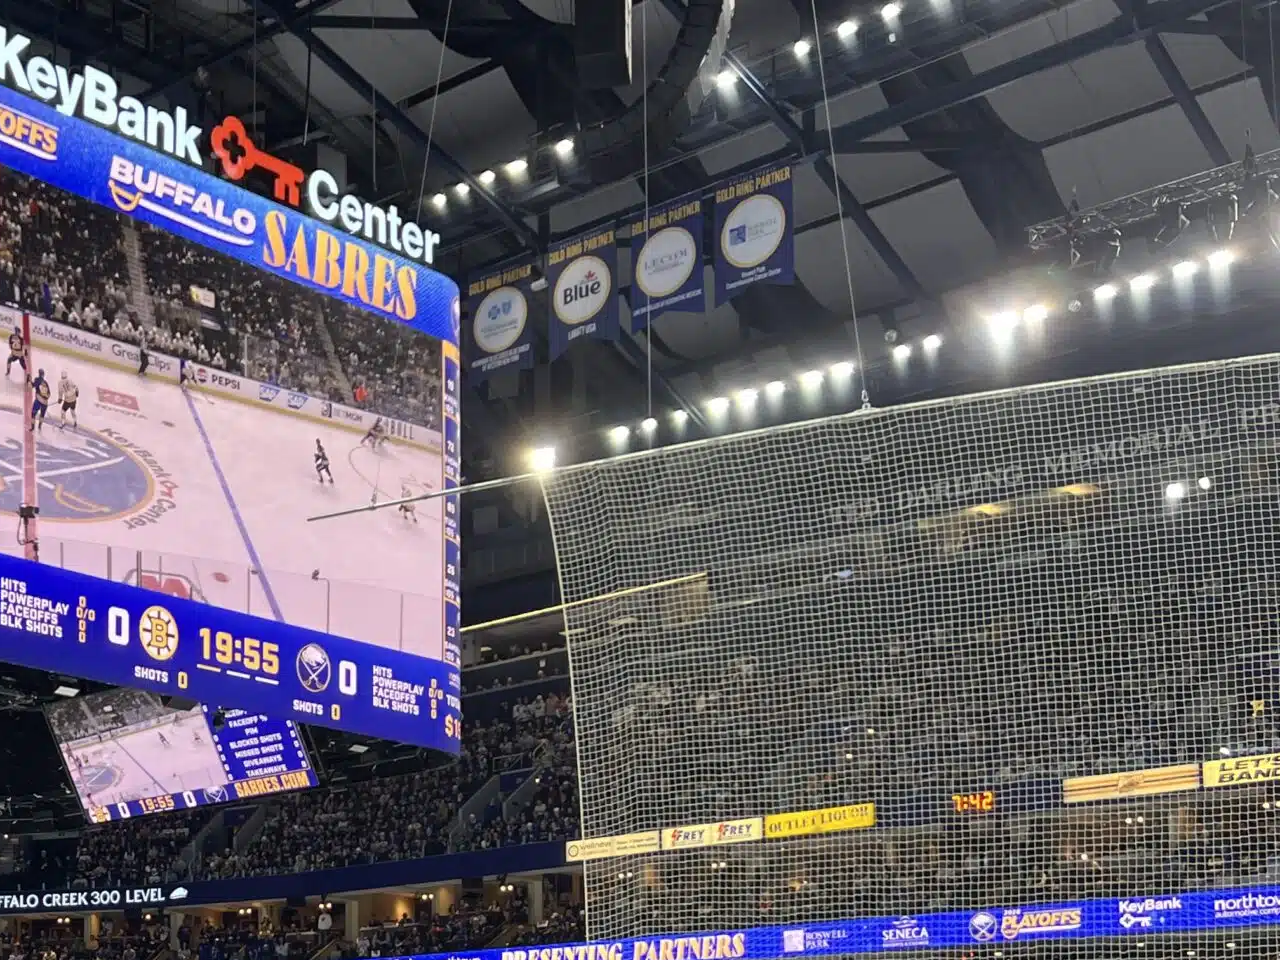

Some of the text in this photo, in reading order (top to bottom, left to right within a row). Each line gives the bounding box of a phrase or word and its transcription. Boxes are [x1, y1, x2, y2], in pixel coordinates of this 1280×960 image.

[109, 154, 257, 234] BUFFALO
[308, 169, 441, 264] Center
[262, 210, 419, 322] SABRES
[563, 279, 602, 306] Blue
[211, 373, 241, 390] PEPSI
[0, 577, 26, 593] HITS
[0, 590, 70, 616] POWERPLAY
[0, 602, 59, 625] FACEOFFS
[0, 613, 63, 638] BLK SHOTS
[107, 606, 131, 646] 0
[199, 627, 280, 675] 19:55
[134, 665, 188, 690] SHOTS 0
[338, 660, 358, 696] 0
[292, 699, 341, 721] SHOTS 0
[234, 770, 311, 798] SABRES.COM
[951, 791, 995, 812] 7:42
[768, 805, 870, 834] OUTLET LIQUOR
[675, 823, 753, 843] FREY FREY
[42, 892, 88, 907] CREEK
[90, 890, 120, 905] 300
[125, 887, 166, 903] LEVEL
[1119, 896, 1181, 914] KeyBank
[882, 926, 929, 940] SENECA
[1001, 908, 1082, 934] PLAYOFFS
